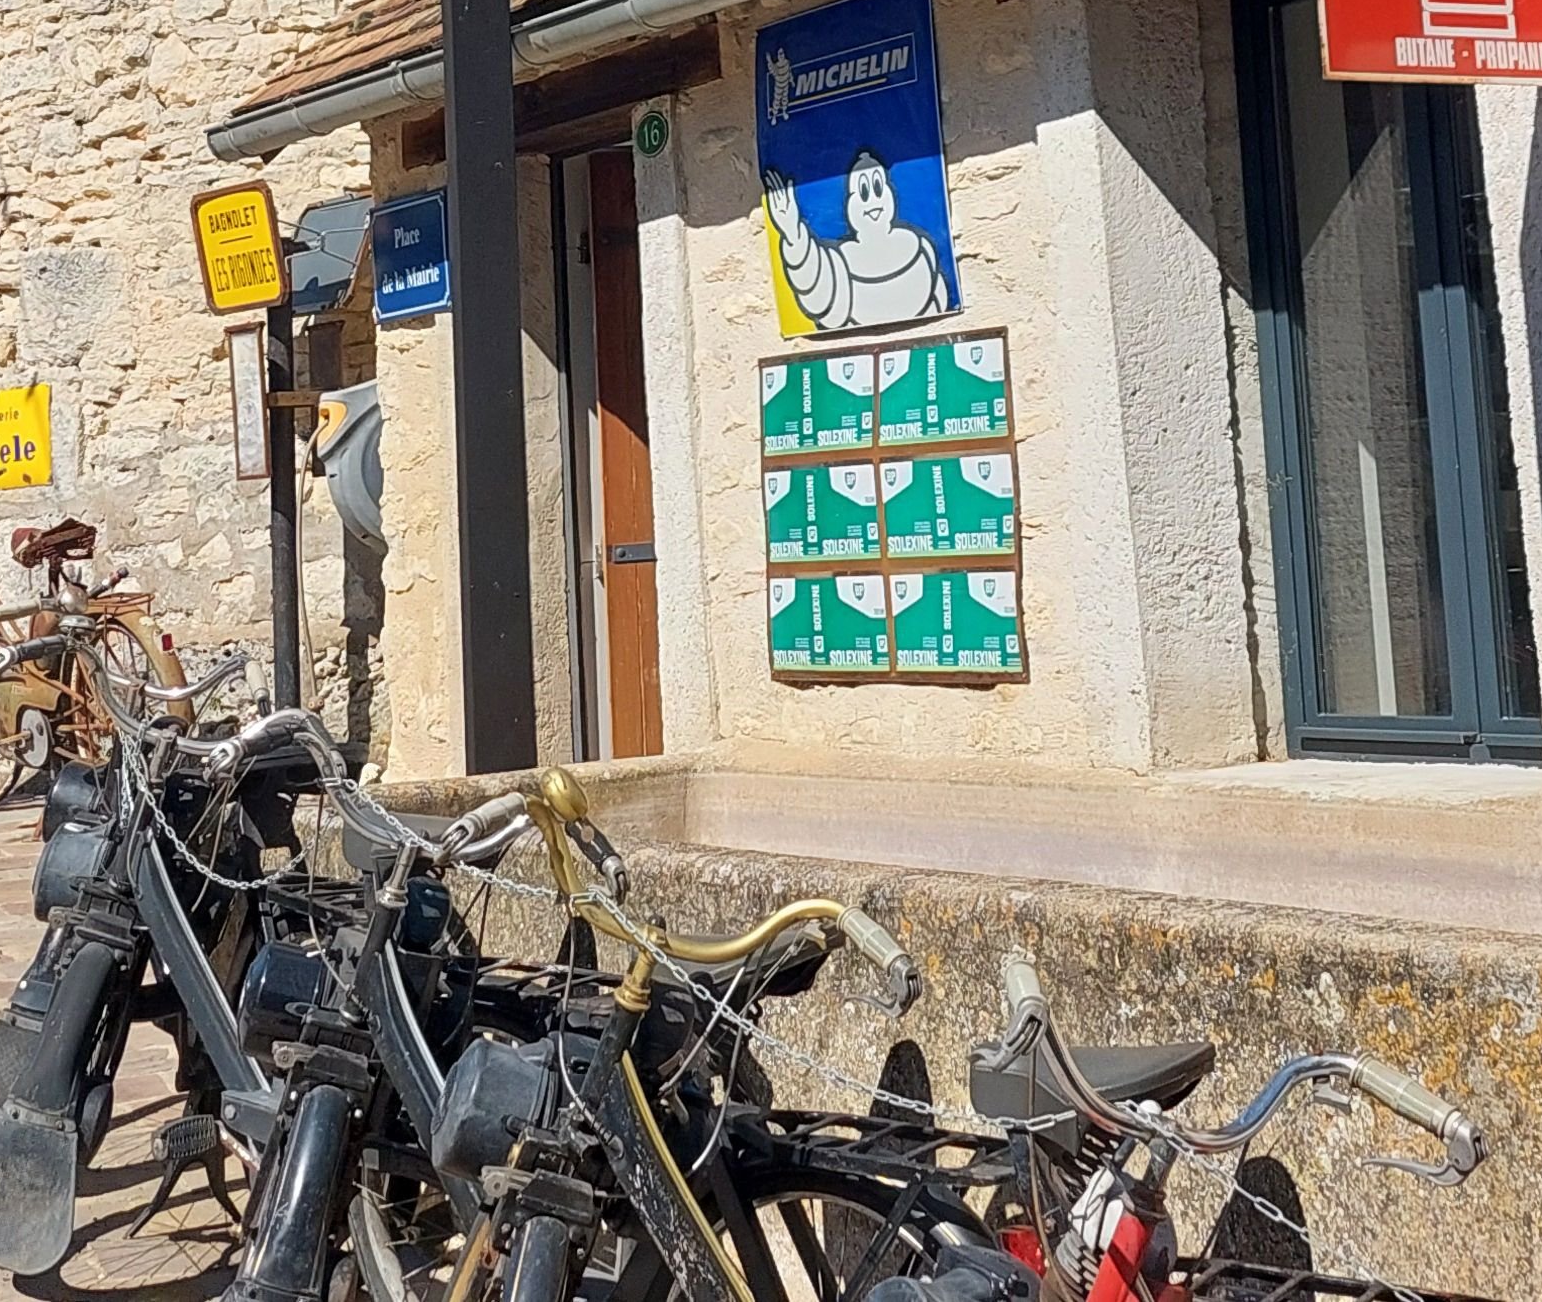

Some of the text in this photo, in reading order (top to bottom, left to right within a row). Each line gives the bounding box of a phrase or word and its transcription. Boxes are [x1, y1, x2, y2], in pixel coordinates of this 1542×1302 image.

[1395, 36, 1456, 69] BUTANE
[795, 46, 909, 97] MICHELIN
[643, 120, 659, 149] 16
[208, 205, 258, 234] BAGNOLET
[394, 227, 420, 249] Place
[211, 247, 277, 292] LES RIGONDES
[382, 262, 440, 294] de la Mairie
[880, 422, 923, 441] SOLEXINE
[944, 416, 990, 435] SOLEXINE
[765, 434, 799, 450] SOLEXINE
[818, 428, 858, 446] SOLEXINE
[932, 465, 945, 514] SOLEXINE
[770, 541, 803, 557] SOLEXINE
[822, 539, 864, 555] SOLEXINE
[887, 535, 933, 553] SOLEXINE
[955, 532, 998, 550] SOLEXINE
[773, 650, 811, 666] SOLEXINE
[830, 650, 872, 666] SOLEXINE
[897, 650, 938, 666] SOLEXINE
[958, 650, 1001, 667] SOLEXINE
